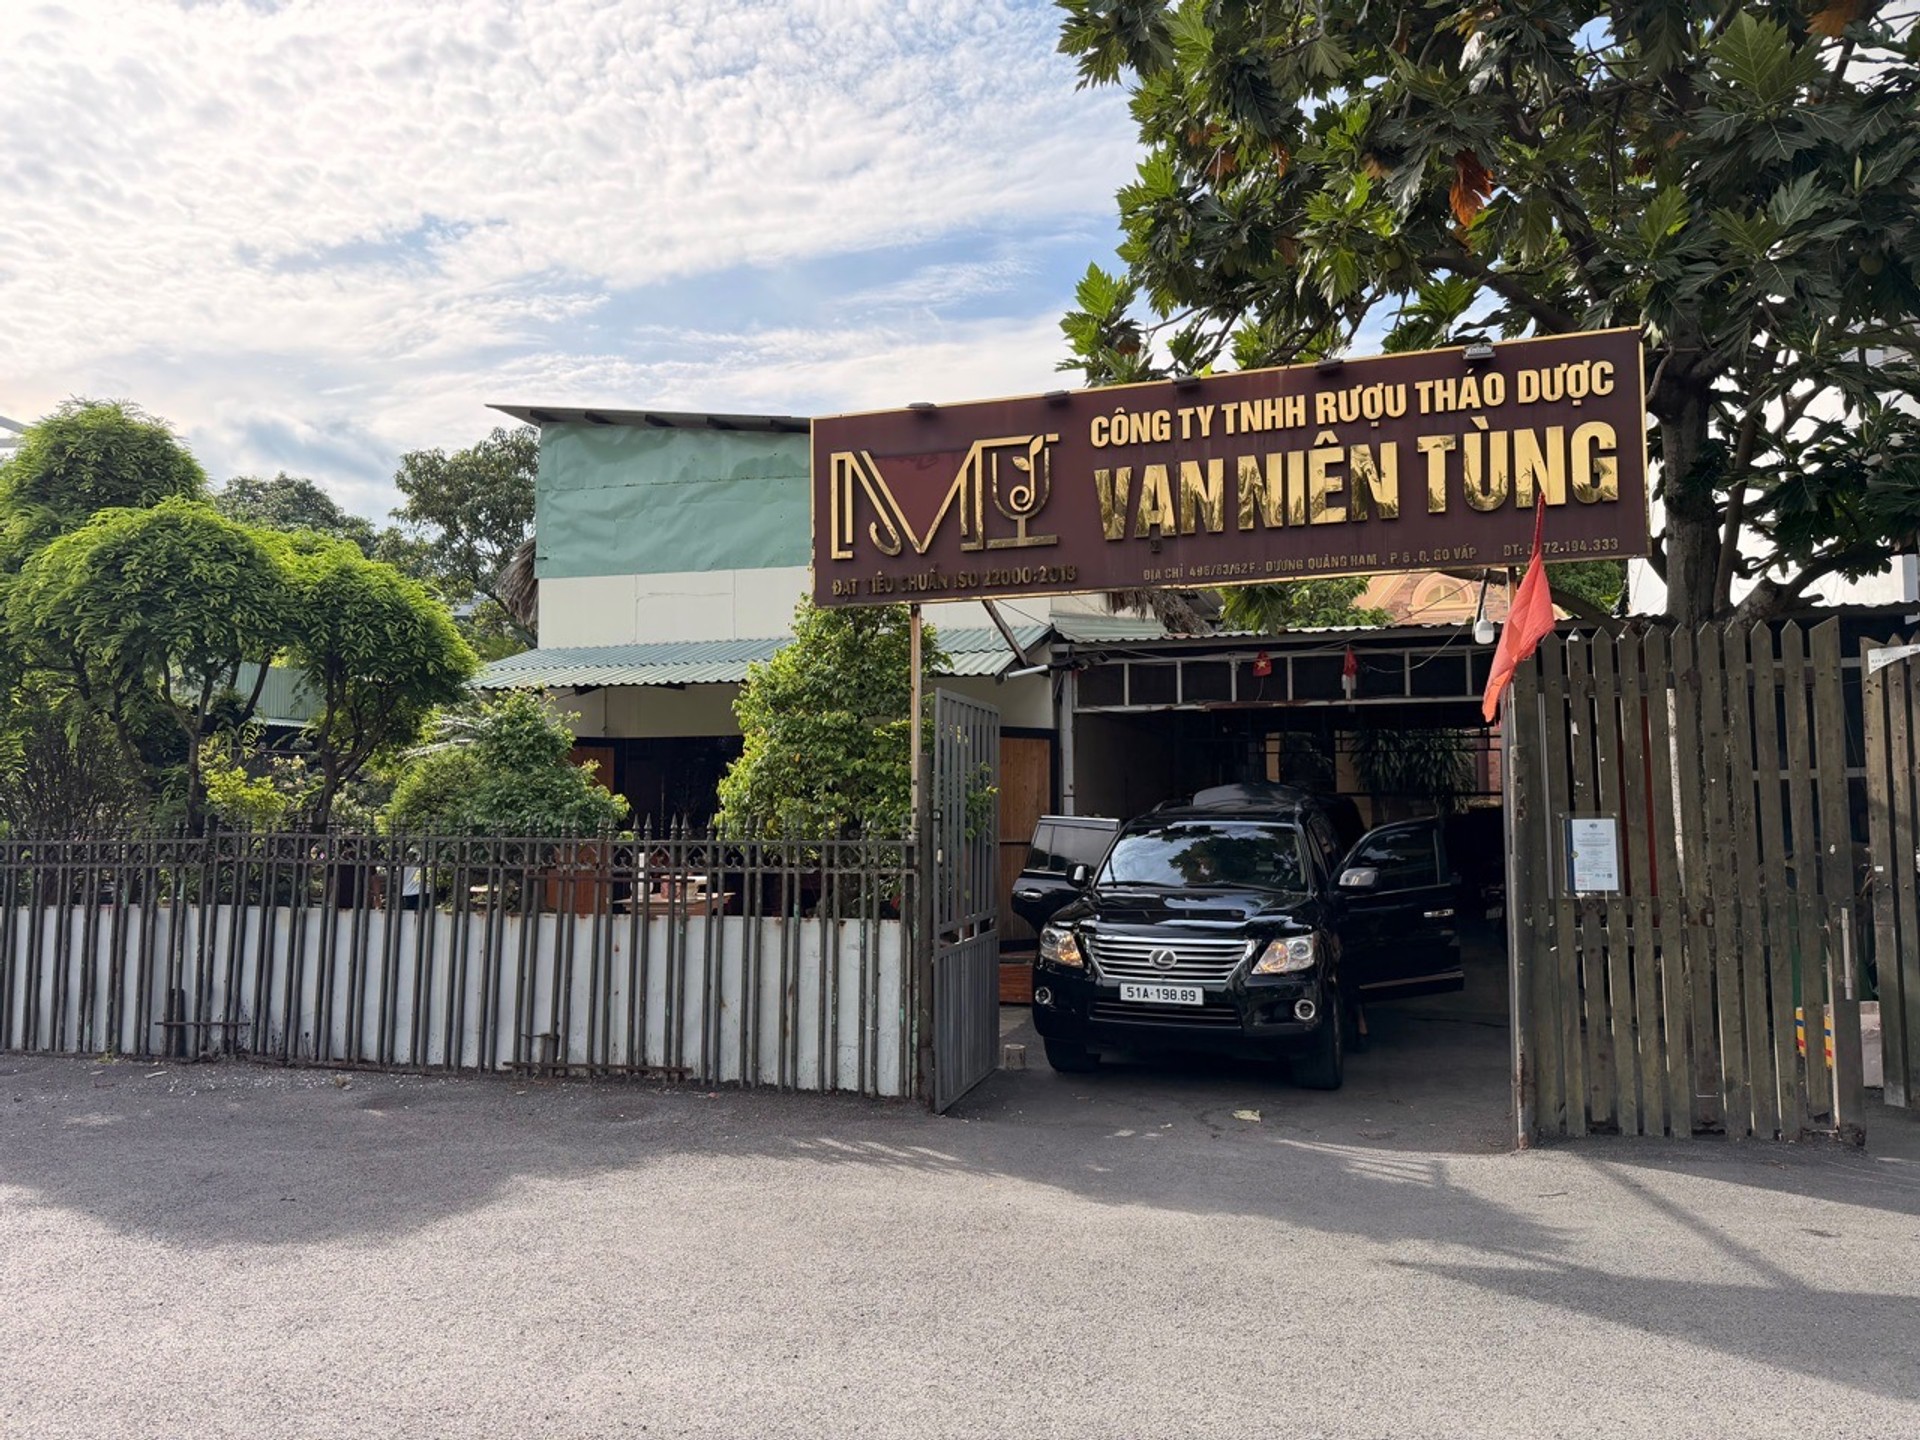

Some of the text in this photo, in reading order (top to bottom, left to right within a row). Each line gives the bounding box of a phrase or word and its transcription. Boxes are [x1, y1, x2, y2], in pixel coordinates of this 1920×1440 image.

[1090, 407, 1172, 449] CÔNG
[1177, 405, 1215, 440] TY
[1221, 395, 1306, 435] TNHH
[1315, 383, 1407, 427] RƯỢU
[1517, 360, 1615, 406] DƯỢC
[1237, 430, 1400, 530] NIÊN
[1417, 416, 1619, 514] TÙNG
